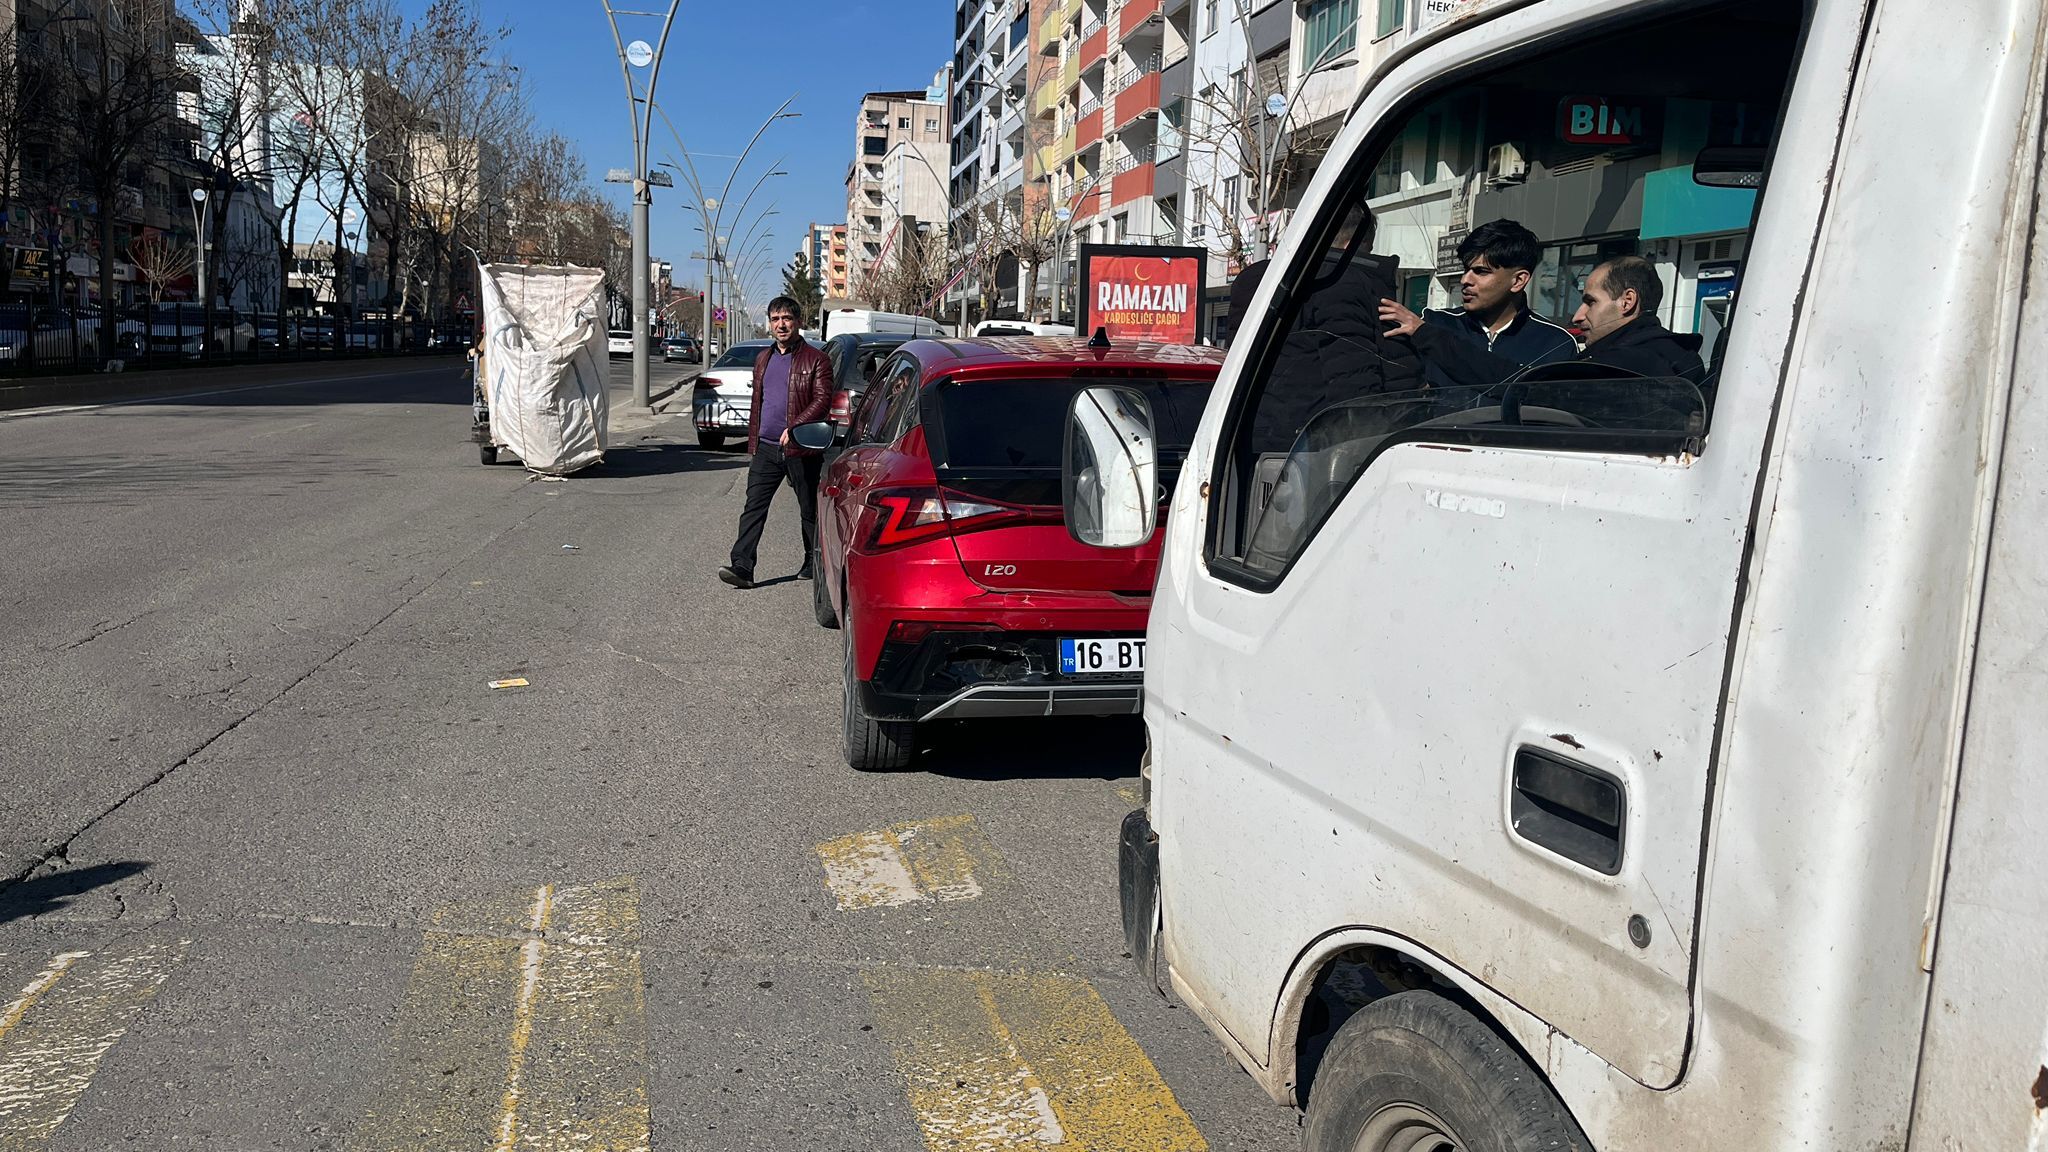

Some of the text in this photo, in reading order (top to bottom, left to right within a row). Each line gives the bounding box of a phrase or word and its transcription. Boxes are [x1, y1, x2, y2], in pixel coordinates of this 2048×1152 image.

[1571, 97, 1642, 135] BİM
[1097, 281, 1187, 312] RAMAZAN
[1063, 658, 1074, 666] TR
[1077, 641, 1146, 669] 16 BT
